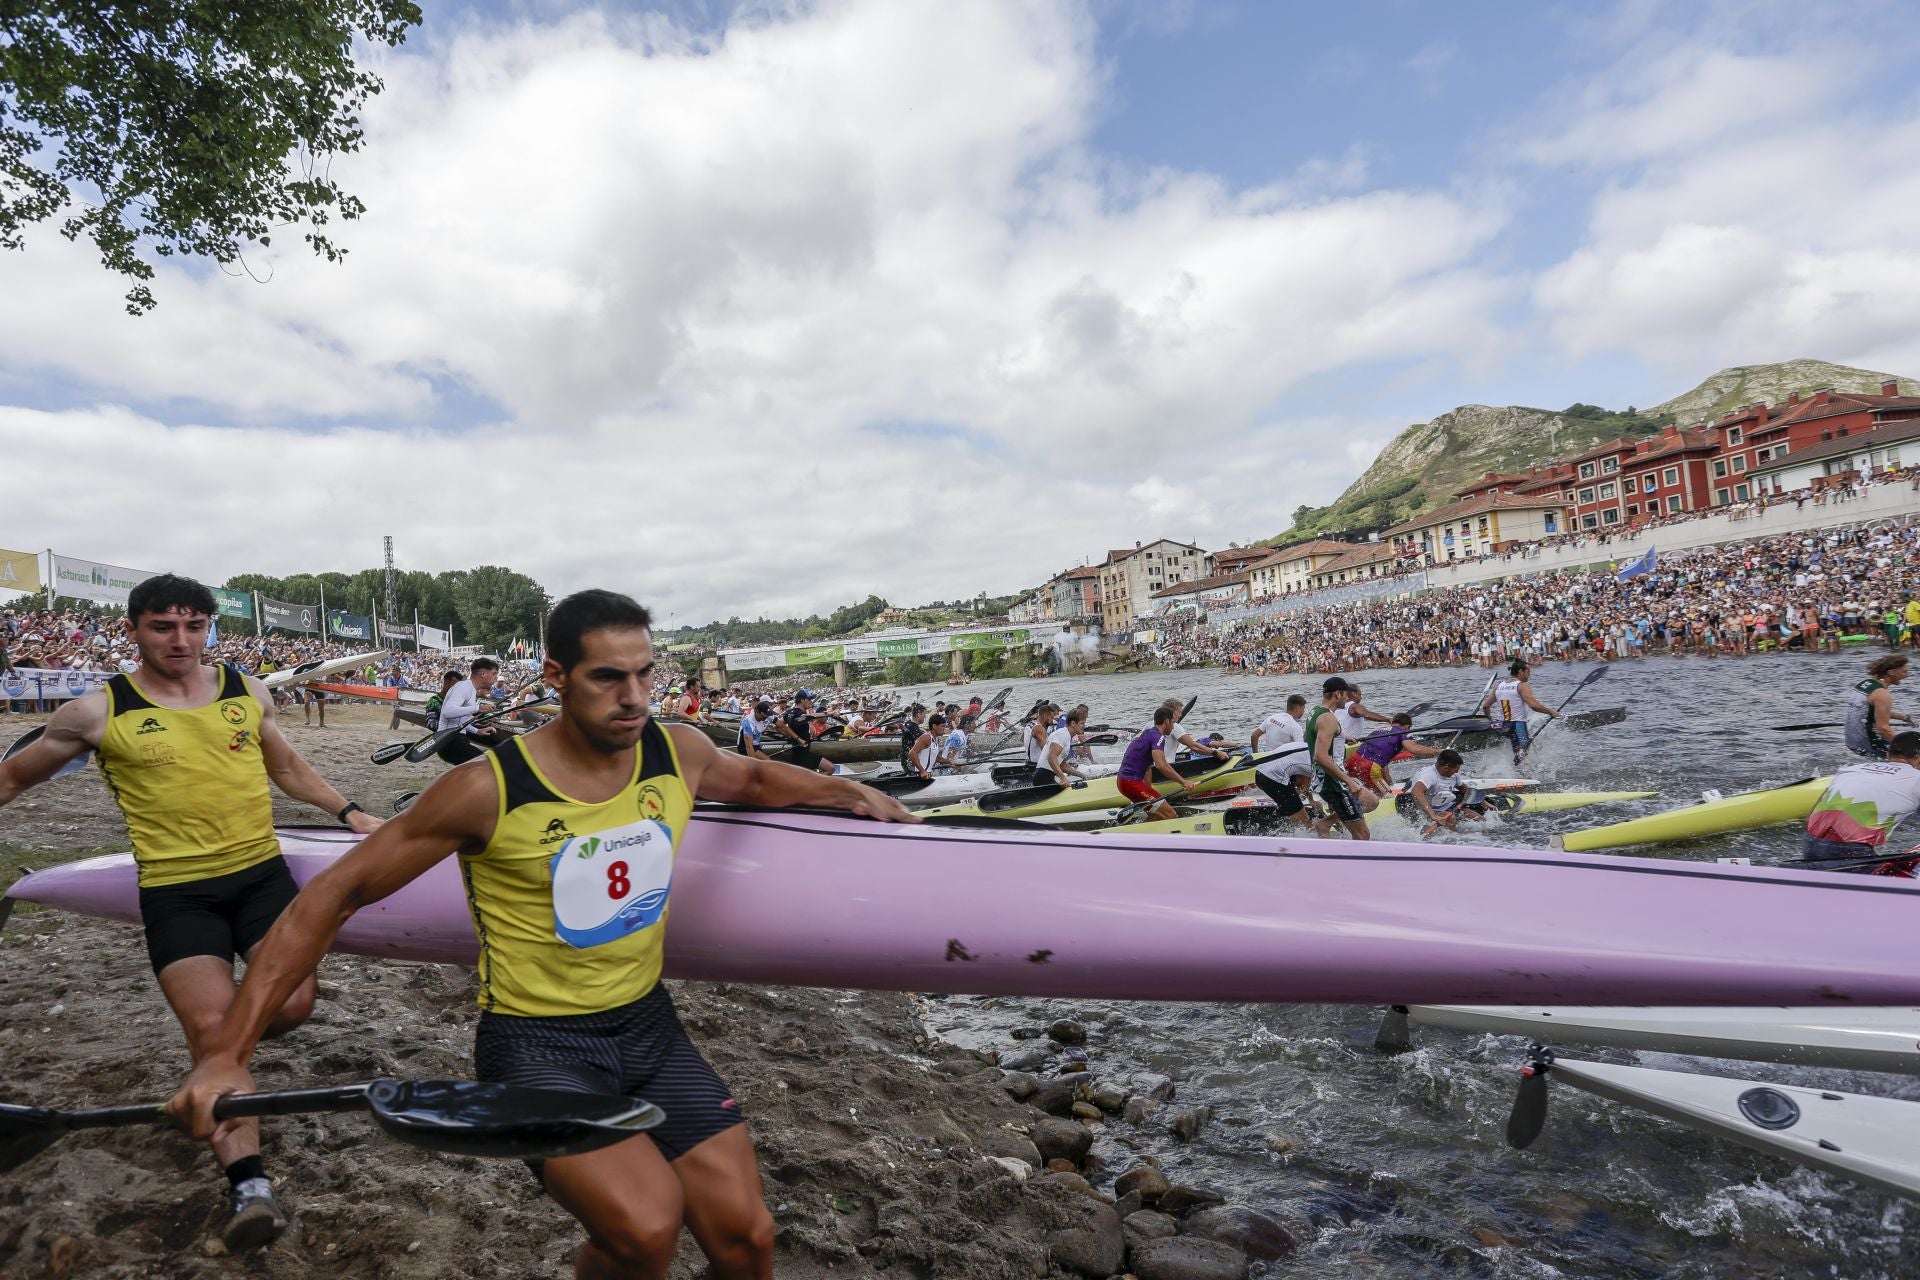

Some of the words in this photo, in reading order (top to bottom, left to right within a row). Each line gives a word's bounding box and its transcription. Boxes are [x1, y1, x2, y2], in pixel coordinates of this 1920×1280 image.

[57, 565, 90, 584] Asturias
[340, 624, 363, 638] Unicaja
[879, 642, 918, 652] PARAÍSO
[963, 798, 973, 806] 10
[604, 831, 652, 853] Unicaja
[606, 860, 632, 901] 8
